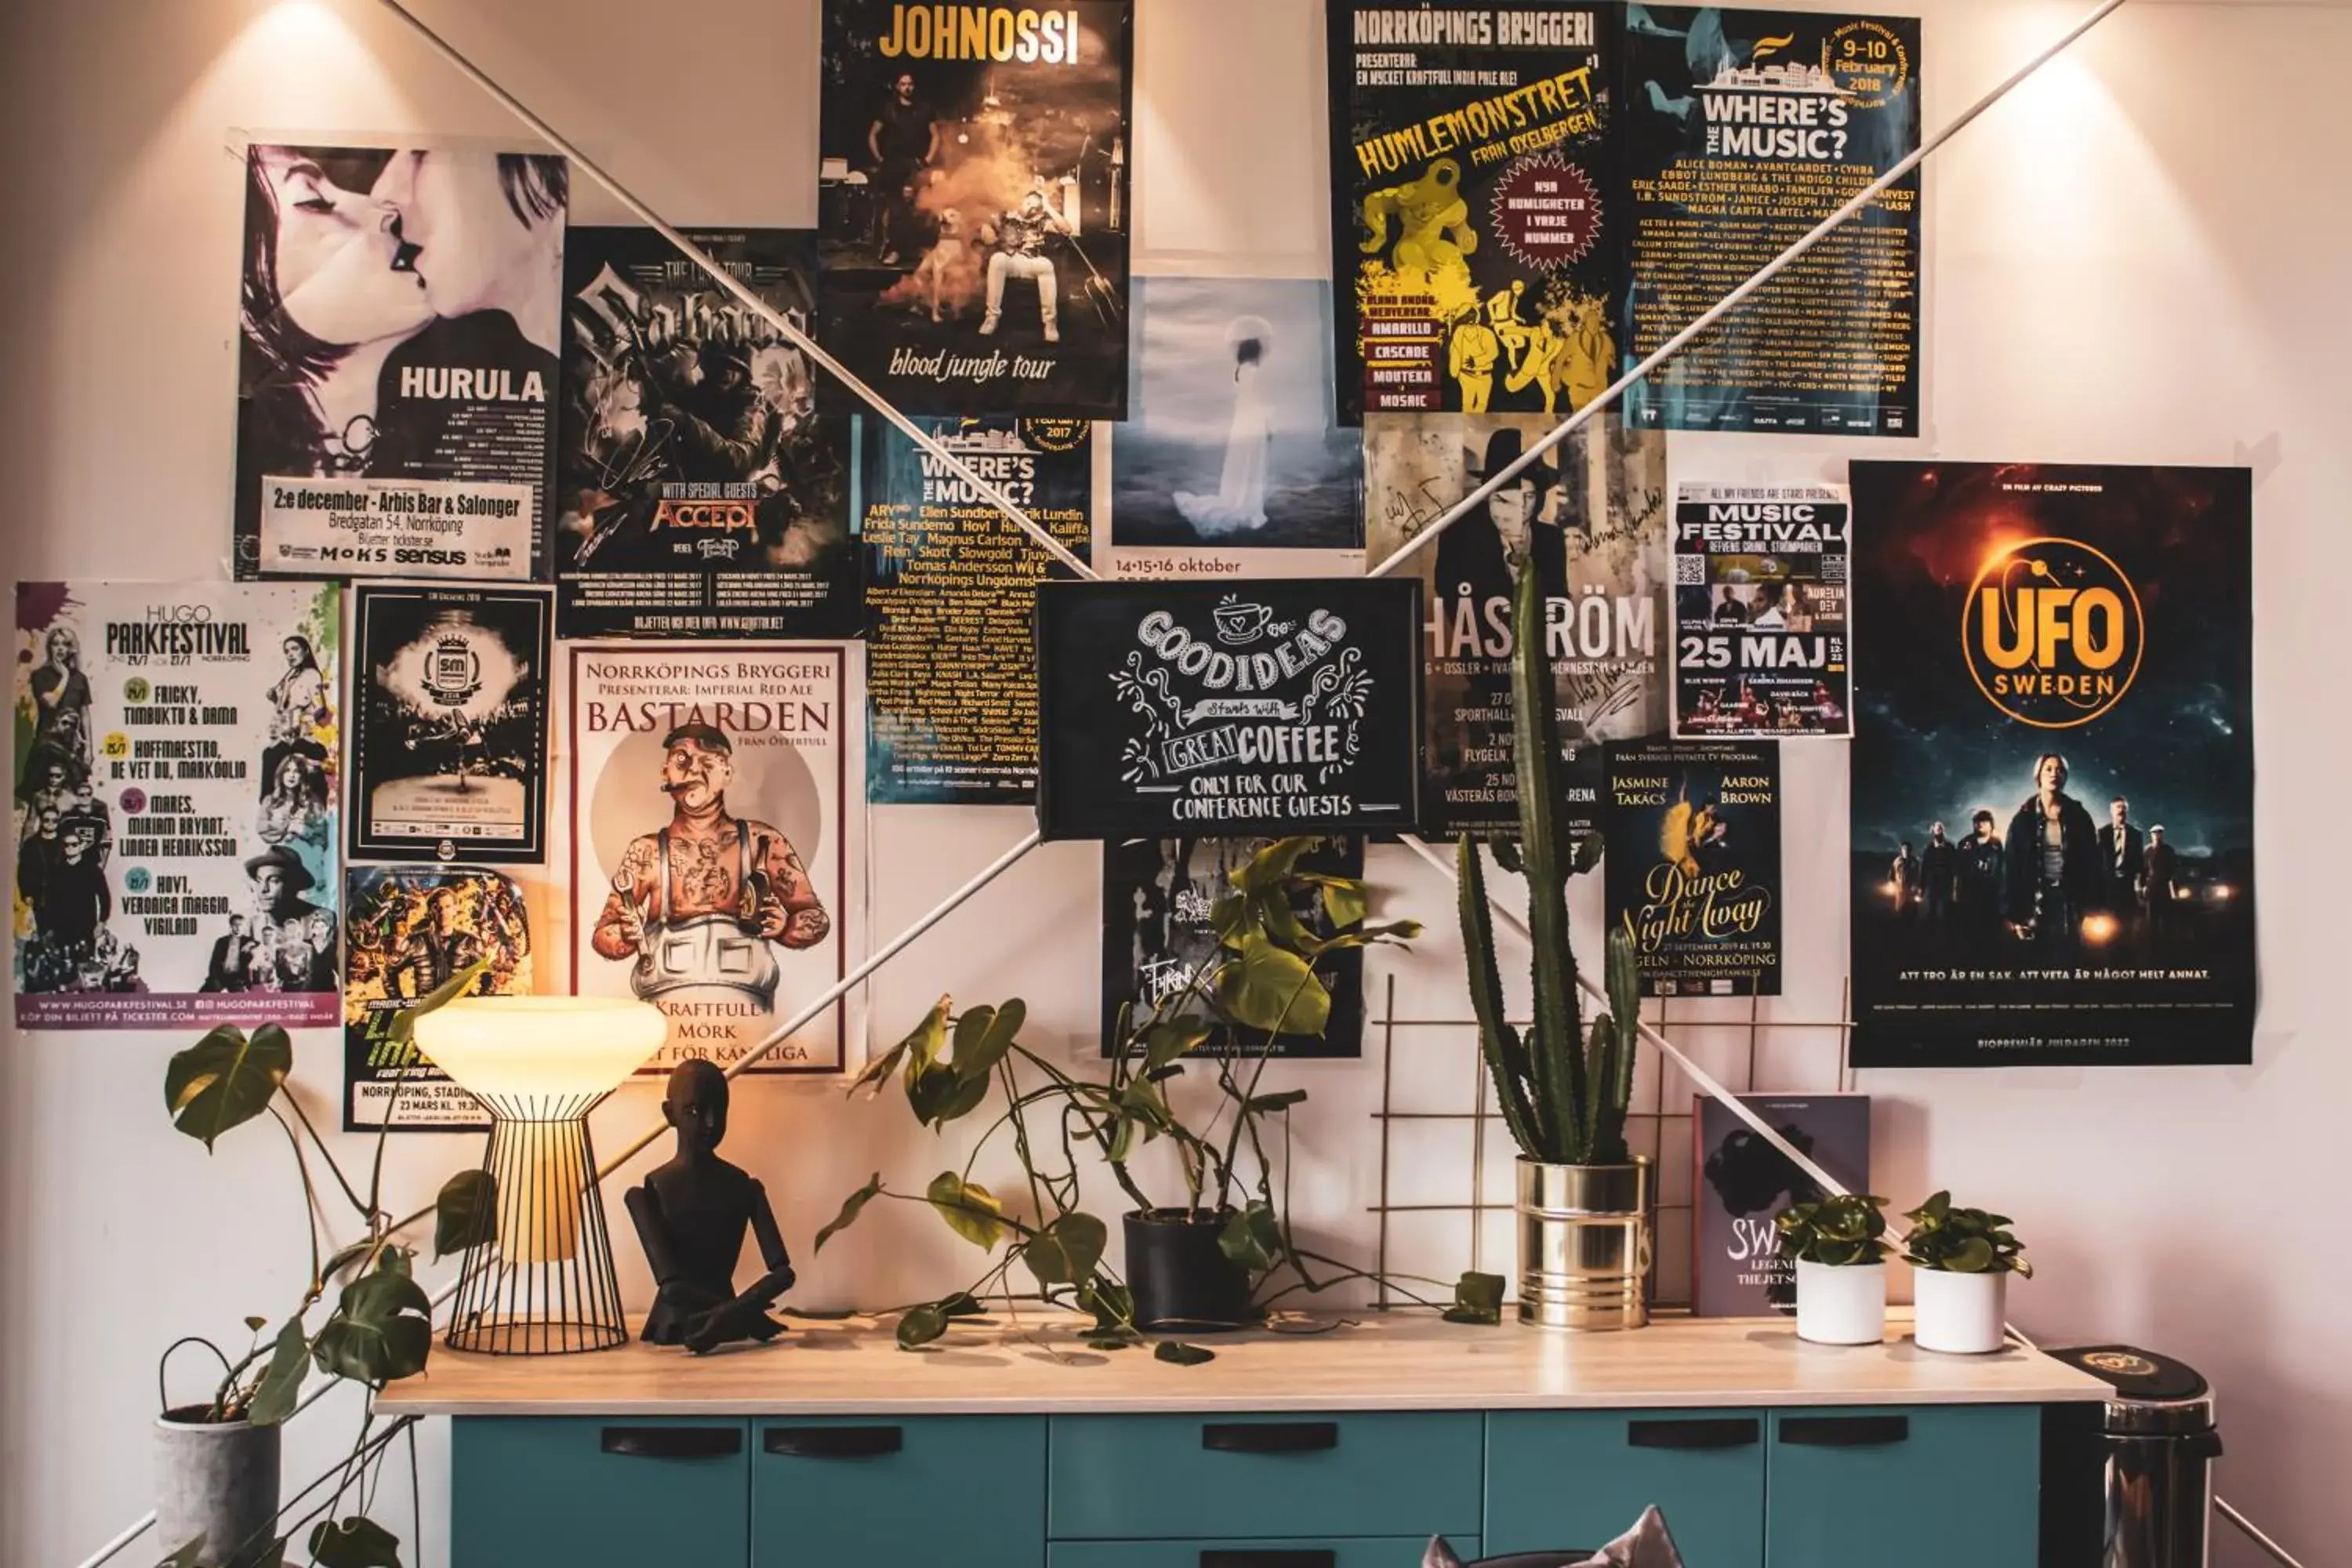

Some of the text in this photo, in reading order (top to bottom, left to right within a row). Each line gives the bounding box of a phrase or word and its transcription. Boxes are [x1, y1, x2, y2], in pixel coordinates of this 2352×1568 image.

[1354, 2, 1594, 46] NORRKÖPINGS BRYGGERI
[880, 5, 1078, 64] JOHNOSSI
[1835, 59, 1896, 77] February
[1356, 70, 1498, 85] EN MYCKET KRAFTFULL PALE
[1849, 78, 1881, 92] 2018
[1703, 94, 1849, 127] WHERE'S
[1356, 66, 1592, 180] HUMLEMONSTRET
[1706, 123, 1847, 159] THE MUSIC?
[1675, 159, 1874, 175] ALICE BOMAN AVANTGARDET CYHRA
[1700, 171, 1832, 184] LUNDBERG THE INDIGO
[1534, 181, 1558, 193] NYA
[1632, 180, 1833, 195] ERIC SAADE ESTHER KIRABO FAMILJEN
[1508, 198, 1584, 211] HUMLIGHETER
[1688, 204, 1804, 216] MAGNA CARTA CARTEL
[1733, 194, 1911, 211] JANICE JOSEPH LASH
[1534, 215, 1567, 226] VARJE
[1524, 232, 1574, 244] NUMMER
[1372, 322, 1432, 335] AMARILLO
[1375, 346, 1429, 358] CASCADE
[889, 348, 1056, 383] blood jungle tour
[401, 366, 546, 401] HURULA
[1380, 394, 1428, 407] MOSAIC
[1047, 427, 1071, 437] 2017
[662, 483, 757, 499] WITH SPECIAL GUESTS
[924, 480, 1034, 505] THE MUSIC?
[1711, 488, 1803, 499] ALL FRIENDS ARE STARS
[274, 488, 520, 518] 2:e december Arbis Bar Salonger
[920, 506, 1083, 521] Ellen Lundin
[1708, 505, 1815, 522] MUSIC
[328, 512, 463, 536] Bredgatan Norrköping
[865, 517, 1088, 534] Frida Sundemo Kaliffa
[1683, 524, 1842, 540] FESTIVAL
[863, 533, 1021, 547] Leslie Tay Magnus Carlson
[394, 548, 466, 565] sensus
[884, 546, 1013, 561] Rein Skott Slowgold
[908, 561, 1014, 573] Tomas Andersson
[1178, 557, 1242, 573] oktober
[899, 574, 974, 587] Norrköpings
[147, 605, 212, 622] HUGO
[1424, 582, 1654, 658] HÅSRÖM
[1981, 586, 2124, 670] UFO
[107, 622, 251, 655] PARKFESTIVAL
[1138, 608, 1347, 691] GOOD IDEAS
[1680, 636, 1825, 668] 25 MAJ
[586, 662, 830, 680] NORRKÖPINGS BRYGGERI
[1446, 662, 1481, 675] OSSLER
[598, 684, 813, 695] PRESENTERAR: IMPERIAL RED ALE
[1994, 674, 2115, 695] SWEDEN
[154, 685, 201, 704] FRICKY,
[1491, 693, 1503, 704] 27
[124, 707, 185, 724] TIMBUKTU
[189, 707, 198, 724] &
[587, 702, 831, 733] BASTARDEN
[1207, 702, 1251, 717] Starts
[738, 735, 765, 746] FRÅN
[1172, 724, 1339, 768] GREAT COFFEE
[1490, 735, 1495, 745] 2
[134, 740, 221, 759] HOFFMAESTRO,
[1465, 749, 1509, 763] FLYGELN,
[111, 761, 246, 780] DE VET DU, MARKOOLIO
[1190, 774, 1308, 795] ONLY FOR OUR
[1486, 775, 1498, 786] 25
[1613, 775, 1769, 789] JASMINE AARON
[1567, 789, 1596, 802] RENA
[1721, 792, 1771, 804] BROWN
[151, 795, 196, 815] MARES,
[1173, 795, 1352, 820] CONFERENCE GUESTS
[128, 817, 227, 836] MIRIAM BRYANT,
[120, 839, 237, 857] LINNEA HENRIKSSON
[1646, 862, 1745, 906] Dance
[122, 896, 232, 915] VERONICA MAGGIO,
[144, 917, 198, 935] VIGILAND
[1624, 887, 1771, 953] Night Away
[1683, 953, 1776, 966] NORRKÖPING
[1900, 971, 1919, 979] ATT
[1923, 971, 1946, 979] TRO
[1969, 971, 1984, 979] EN
[2019, 971, 2039, 979] ATT
[2042, 971, 2069, 979] VETA
[2094, 967, 2136, 979] NÅGOT
[2139, 970, 2165, 979] HELT
[39, 1000, 315, 1010] WWW.HUGOPARKFESTIVAL.SE HUGOPARKFESTIVAL
[655, 1000, 760, 1017] KRAFTFULL
[45, 1013, 62, 1022] DIN
[65, 1012, 101, 1022] BILJETT
[105, 1011, 118, 1022] PÅ
[122, 1012, 194, 1022] TICKSTER.COM
[677, 1022, 737, 1039] MÖRK
[673, 1044, 808, 1060] FÖR KÄNLIGA
[400, 1100, 455, 1110] 23 MARS KL.
[1751, 1260, 1797, 1271] LEGEN
[1737, 1275, 1784, 1286] THE JET
